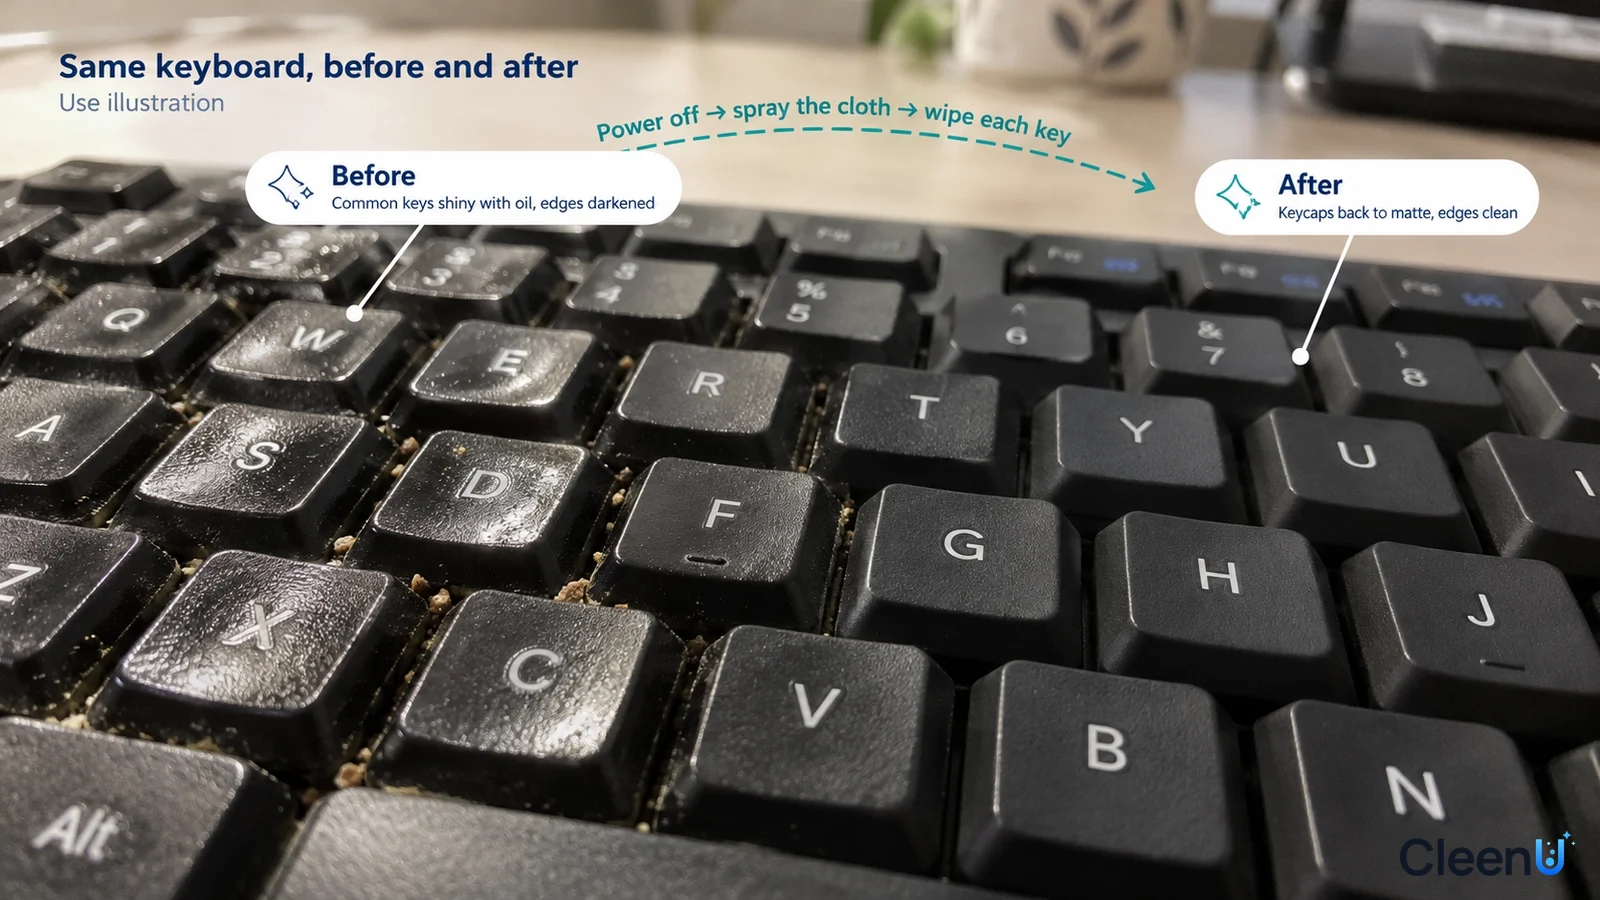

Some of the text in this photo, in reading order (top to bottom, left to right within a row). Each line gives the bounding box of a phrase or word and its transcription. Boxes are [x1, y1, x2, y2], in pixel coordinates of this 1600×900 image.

[103, 306, 148, 333] Q
[786, 302, 812, 323] 5
[289, 324, 348, 352] W
[1005, 326, 1028, 345] 6
[488, 348, 528, 376] E
[1201, 344, 1226, 366] 7
[691, 371, 725, 396] R
[1401, 367, 1429, 388] 8
[909, 394, 940, 420] T
[15, 414, 62, 442] A
[1119, 416, 1153, 444] Y
[235, 440, 281, 470] S
[1337, 440, 1377, 469] U
[459, 469, 509, 500] D
[1574, 470, 1596, 497] I
[704, 498, 741, 529] F
[943, 528, 985, 561] G
[1197, 557, 1240, 595] H
[1467, 593, 1496, 627] J
[222, 601, 297, 650] X
[506, 647, 562, 692] C
[793, 683, 841, 729] V
[1087, 723, 1128, 772] B
[1385, 765, 1446, 821] N
[31, 804, 119, 862] Alt
